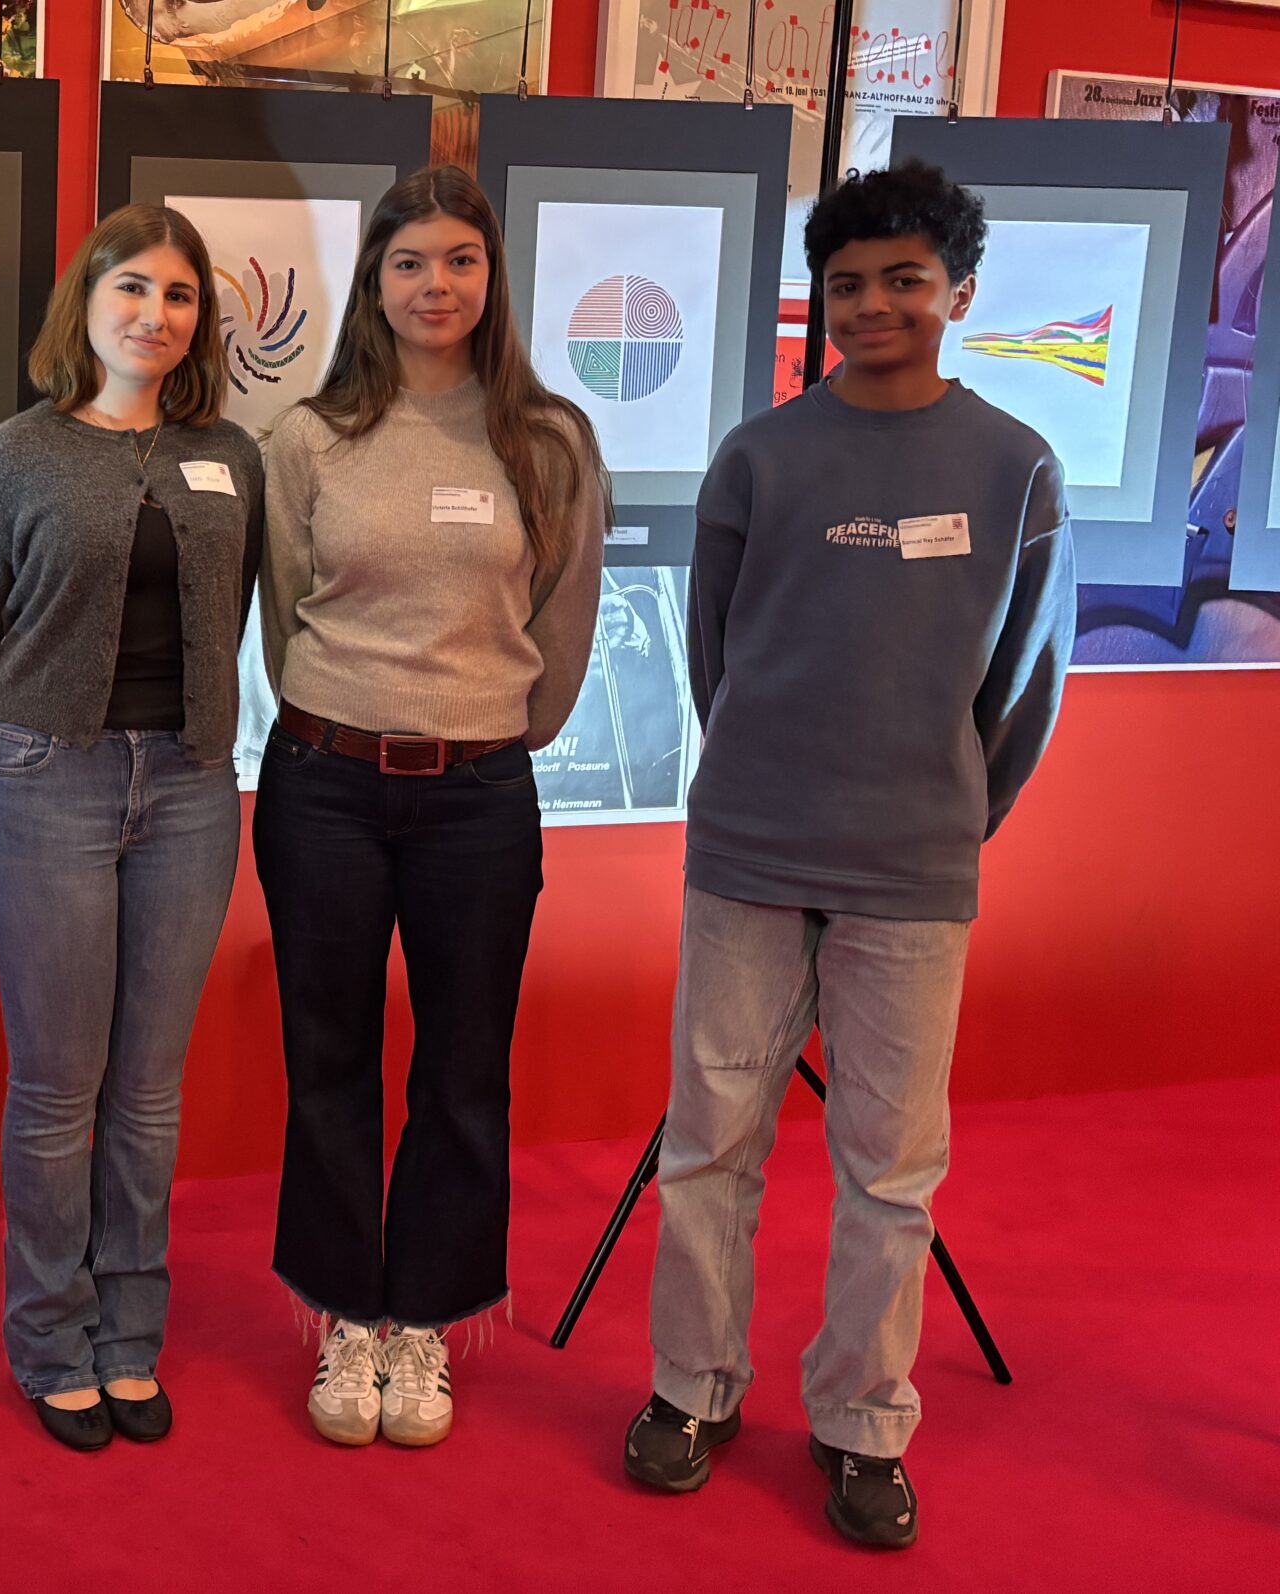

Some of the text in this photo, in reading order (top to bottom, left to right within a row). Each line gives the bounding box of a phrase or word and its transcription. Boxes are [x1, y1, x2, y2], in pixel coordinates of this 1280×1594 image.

[785, 86, 794, 96] 18.
[810, 87, 827, 98] 1951
[1084, 84, 1105, 103] 28.
[1133, 88, 1163, 107] Jazz
[924, 96, 934, 105] 20
[825, 522, 899, 541] PEACEFU
[567, 761, 610, 772] Posaune
[552, 798, 602, 810] Herrmann
